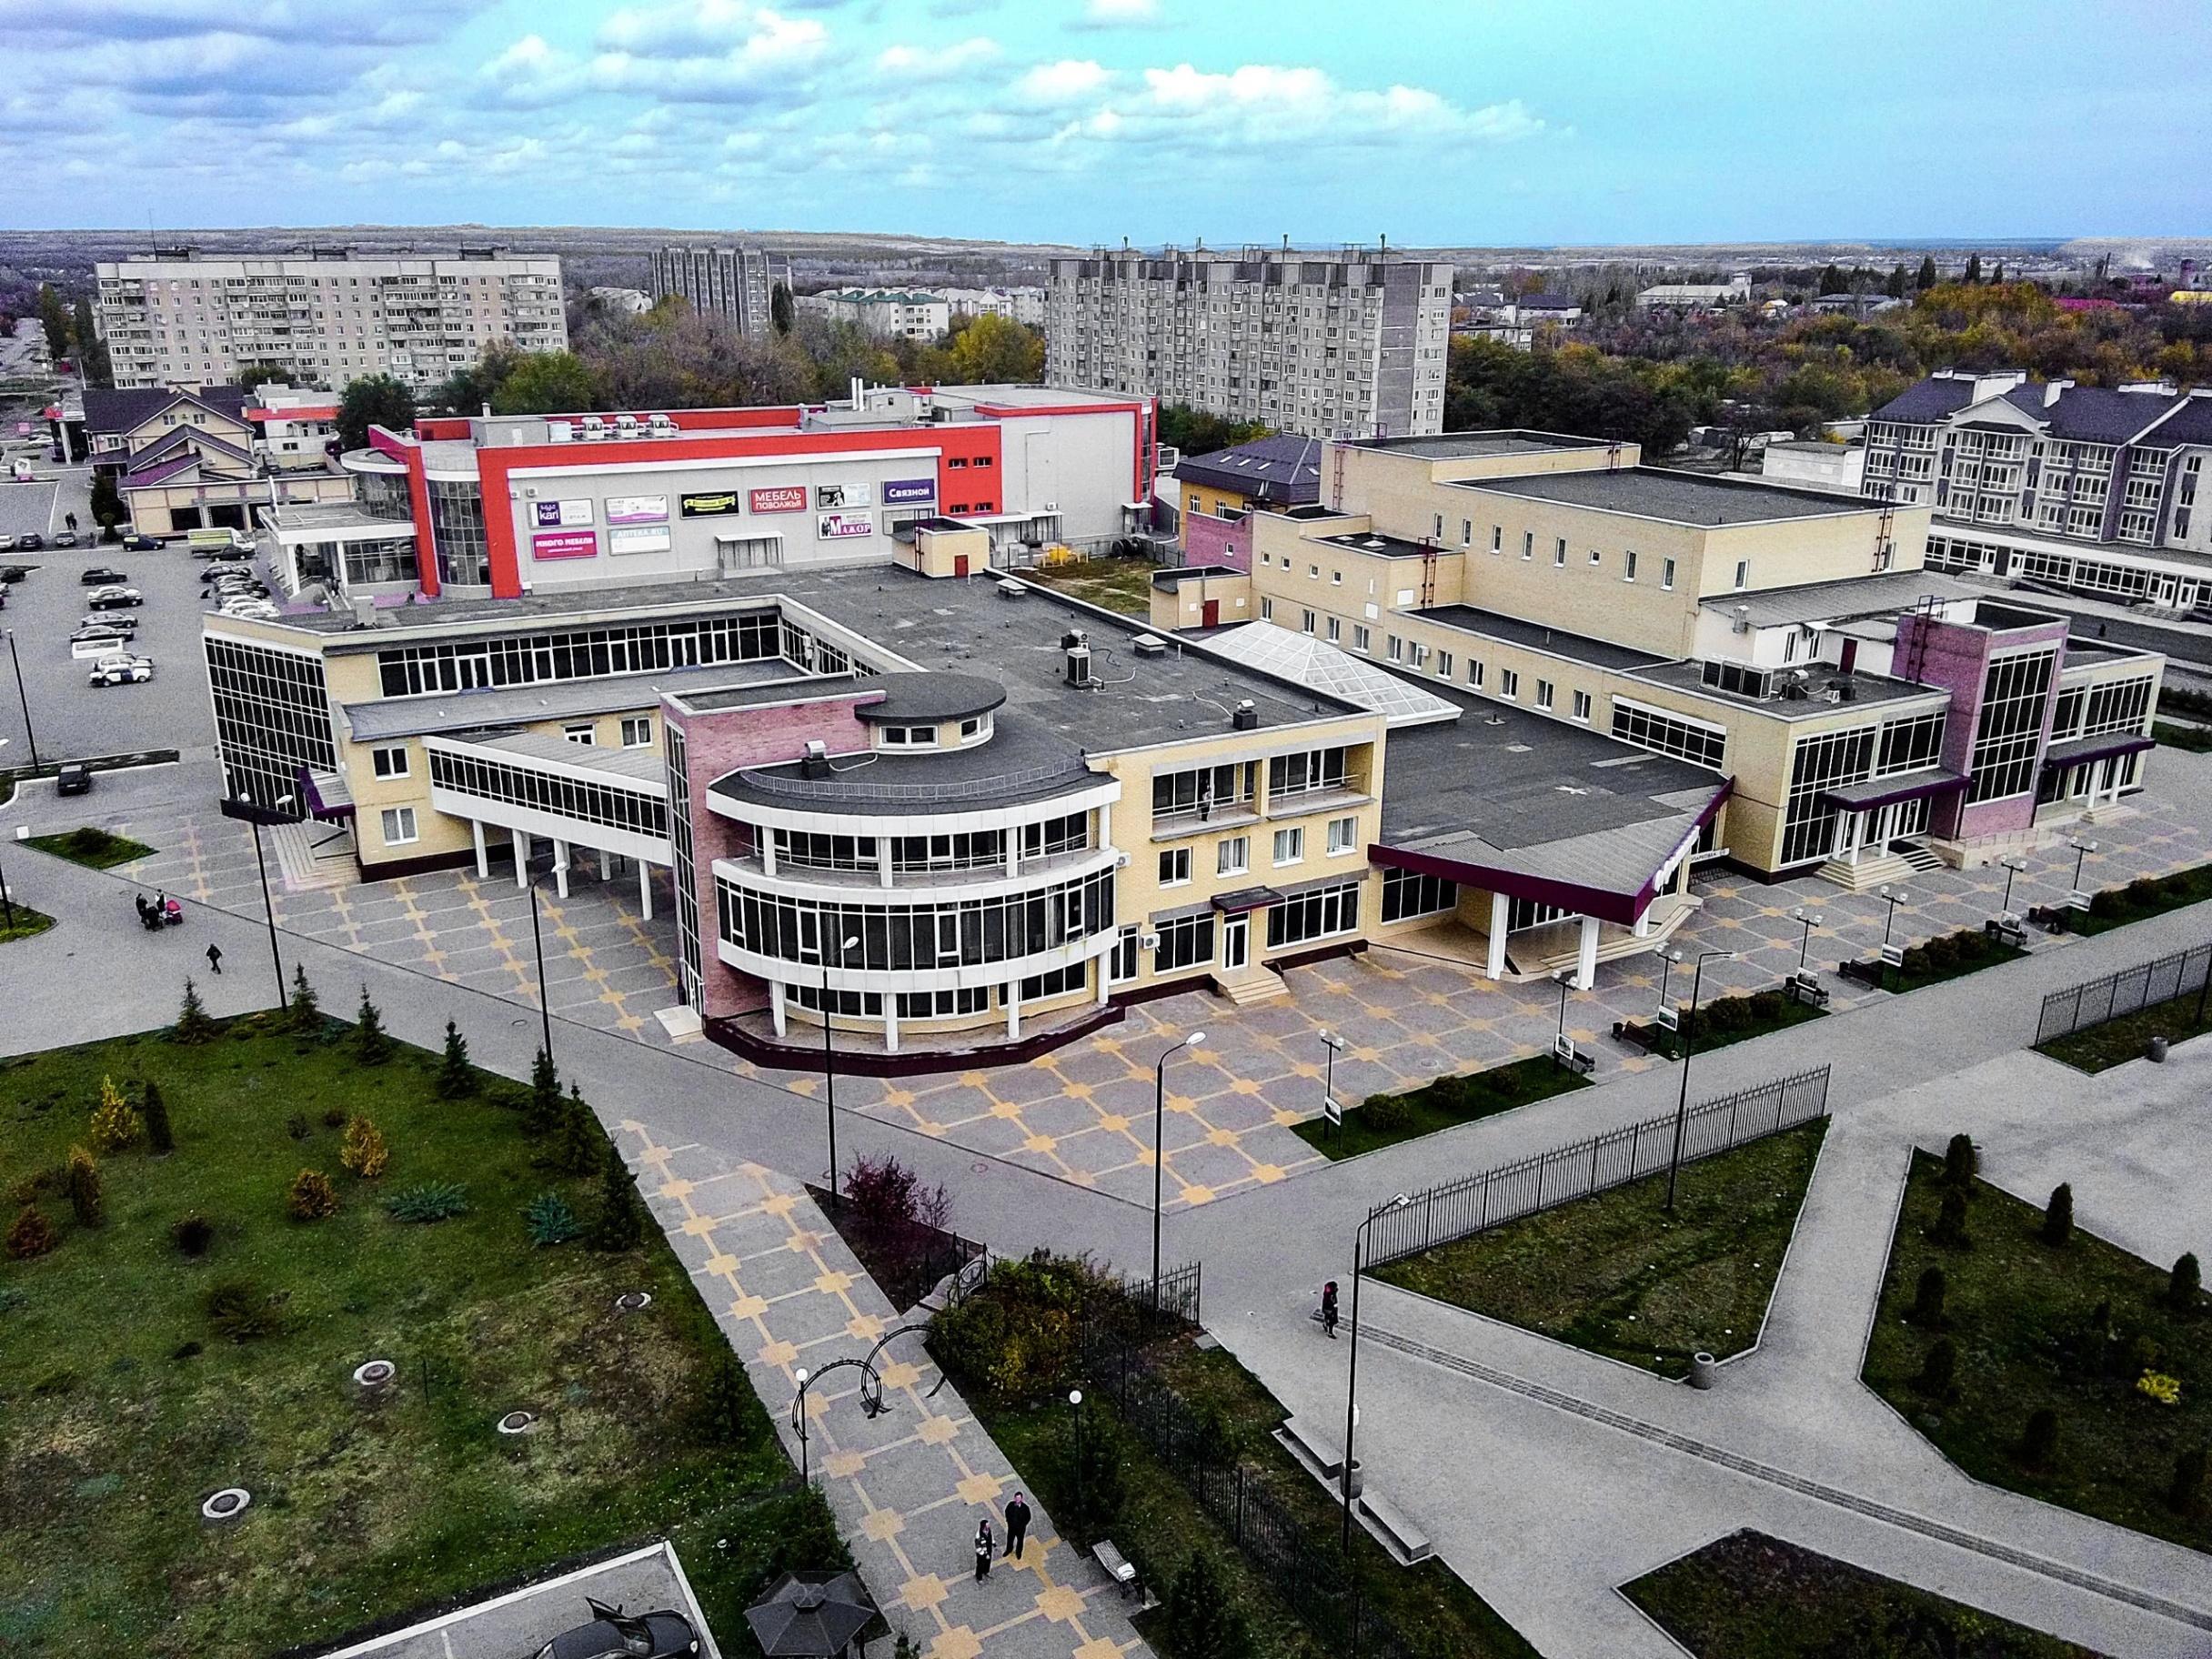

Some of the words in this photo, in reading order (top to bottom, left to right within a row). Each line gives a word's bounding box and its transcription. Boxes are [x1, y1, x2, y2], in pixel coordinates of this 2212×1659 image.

[755, 489, 801, 502] МЕБЕЛЬ
[756, 499, 802, 509] ПОВОЛЖЬЯ
[538, 509, 559, 520] kari
[535, 538, 564, 548] МНОГО
